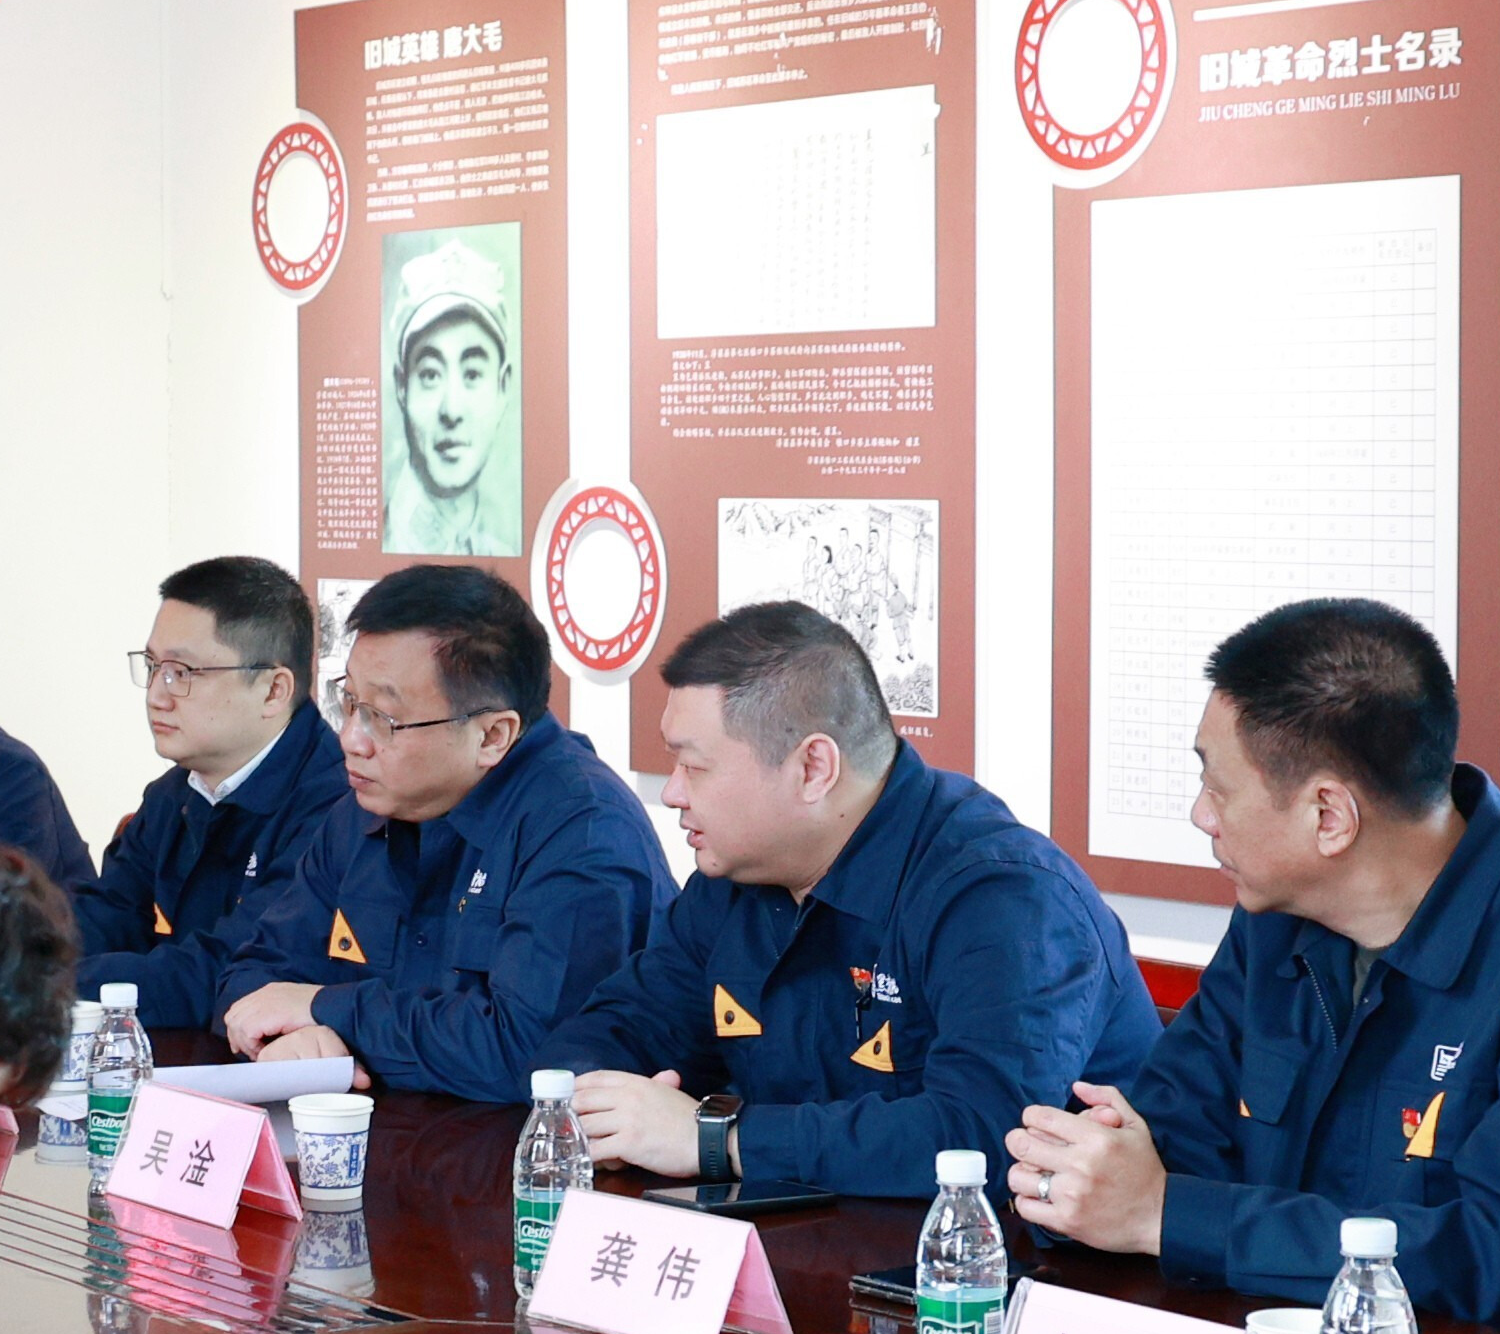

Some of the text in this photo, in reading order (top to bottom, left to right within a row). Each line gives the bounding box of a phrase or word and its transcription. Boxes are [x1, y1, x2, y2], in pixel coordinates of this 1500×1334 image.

[1199, 27, 1462, 93] 旧城革命烈士名录
[1198, 82, 1461, 122] JIU CHENG GE MING LIE SHI MING LU
[139, 1128, 216, 1188] 吴淦
[590, 1230, 701, 1301] 龚伟
